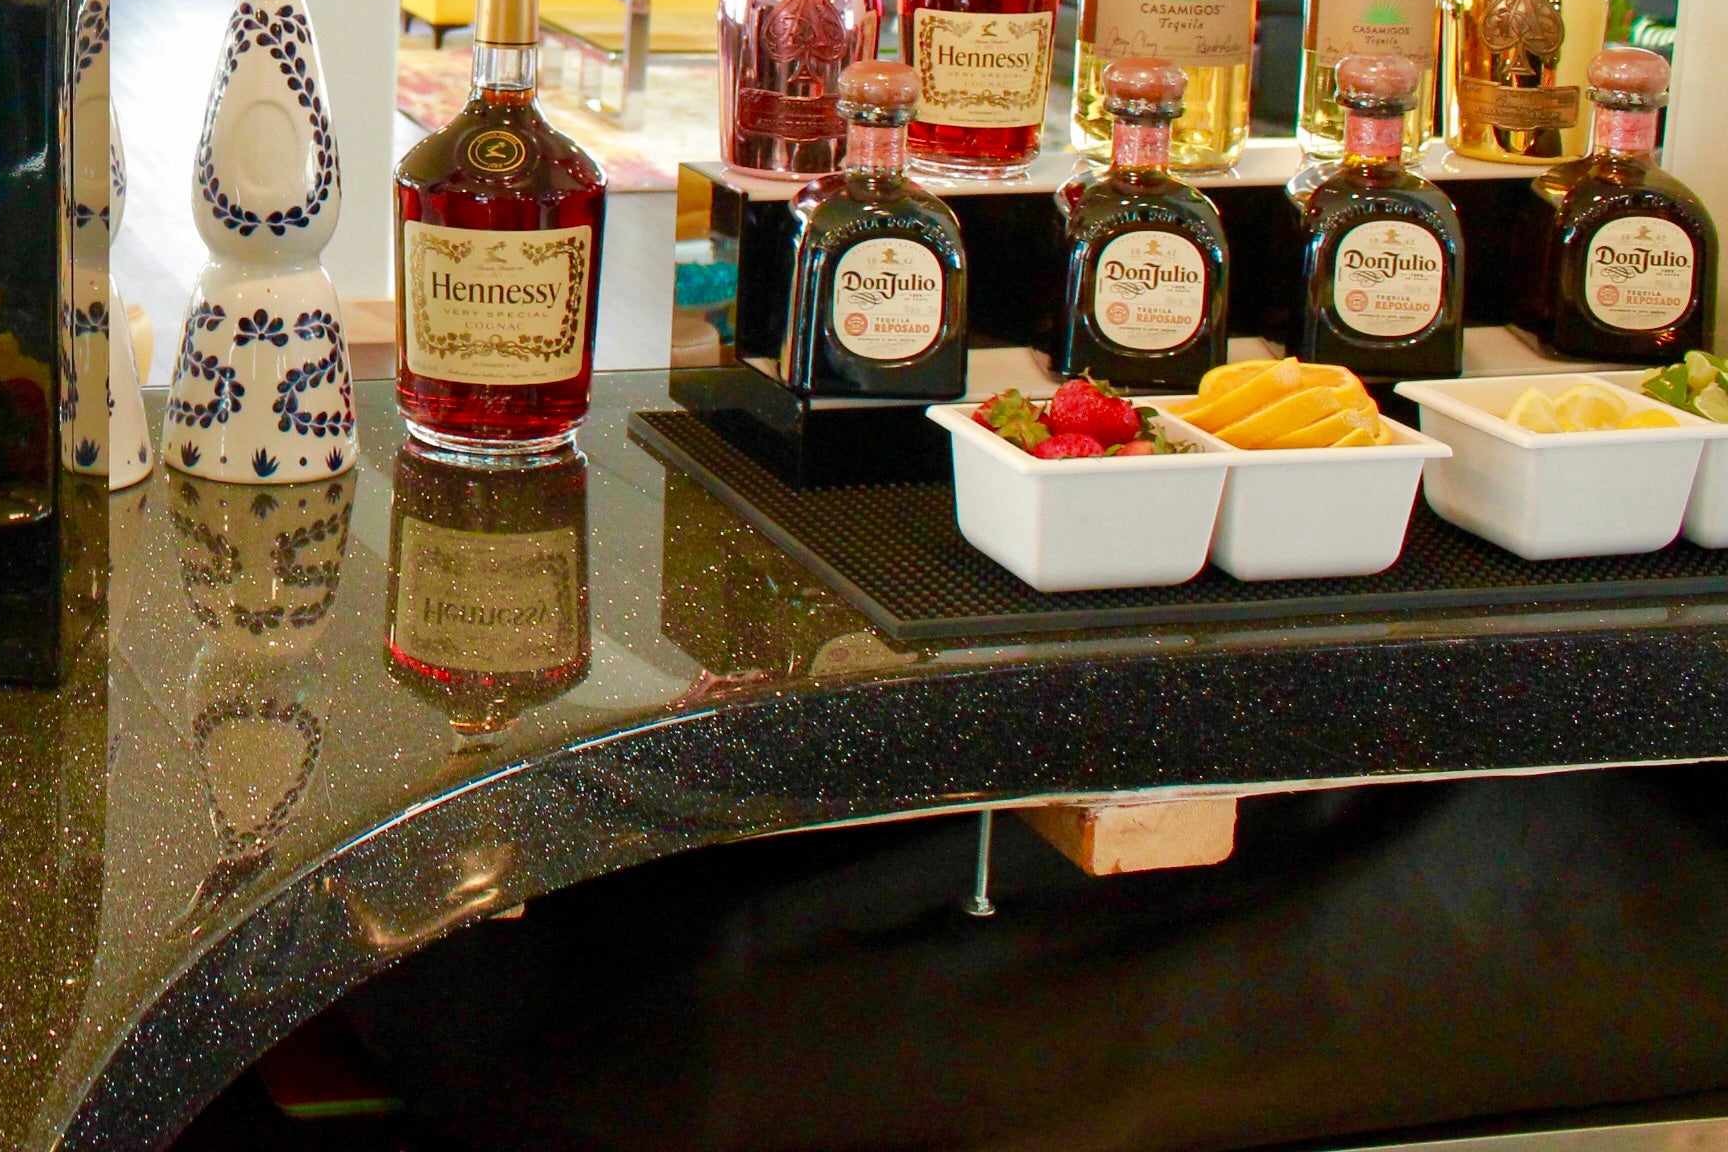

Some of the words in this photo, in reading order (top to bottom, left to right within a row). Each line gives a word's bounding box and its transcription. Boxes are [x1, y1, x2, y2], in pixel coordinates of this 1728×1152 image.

[1140, 3, 1221, 16] CASAMIGOS
[1159, 18, 1205, 33] Tequila
[1352, 25, 1410, 35] CASAMIGOS
[937, 45, 1033, 71] Hennessy
[432, 272, 562, 309] Hennessy
[1374, 301, 1430, 312] REPOSADO
[1626, 297, 1681, 307] REPOSADO
[444, 307, 479, 317] VERY
[1136, 313, 1192, 325] REPOSADO
[465, 321, 522, 331] COGNAC
[874, 323, 930, 334] REPOSADO
